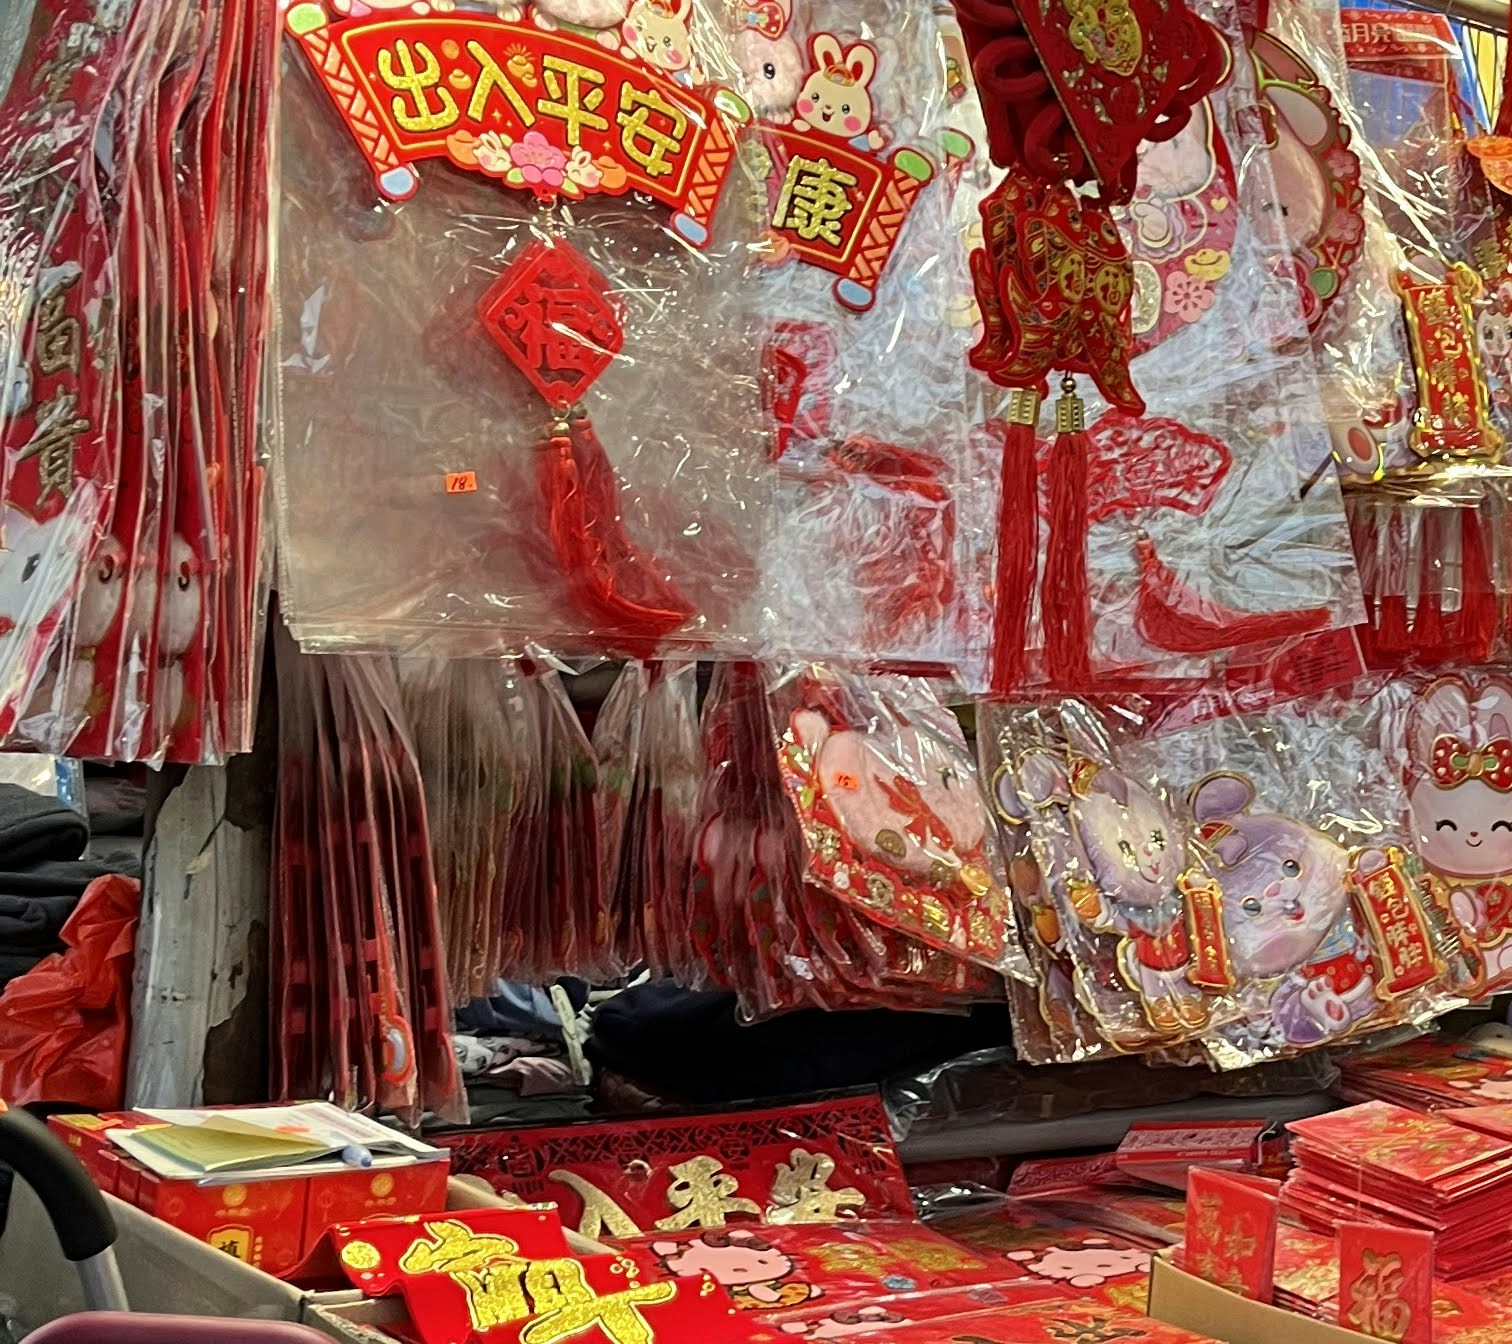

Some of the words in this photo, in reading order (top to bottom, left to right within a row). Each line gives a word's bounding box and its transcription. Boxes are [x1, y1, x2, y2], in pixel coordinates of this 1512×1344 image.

[378, 38, 688, 179] 出入平安
[771, 154, 858, 247] 康
[1347, 1247, 1413, 1344] 福
